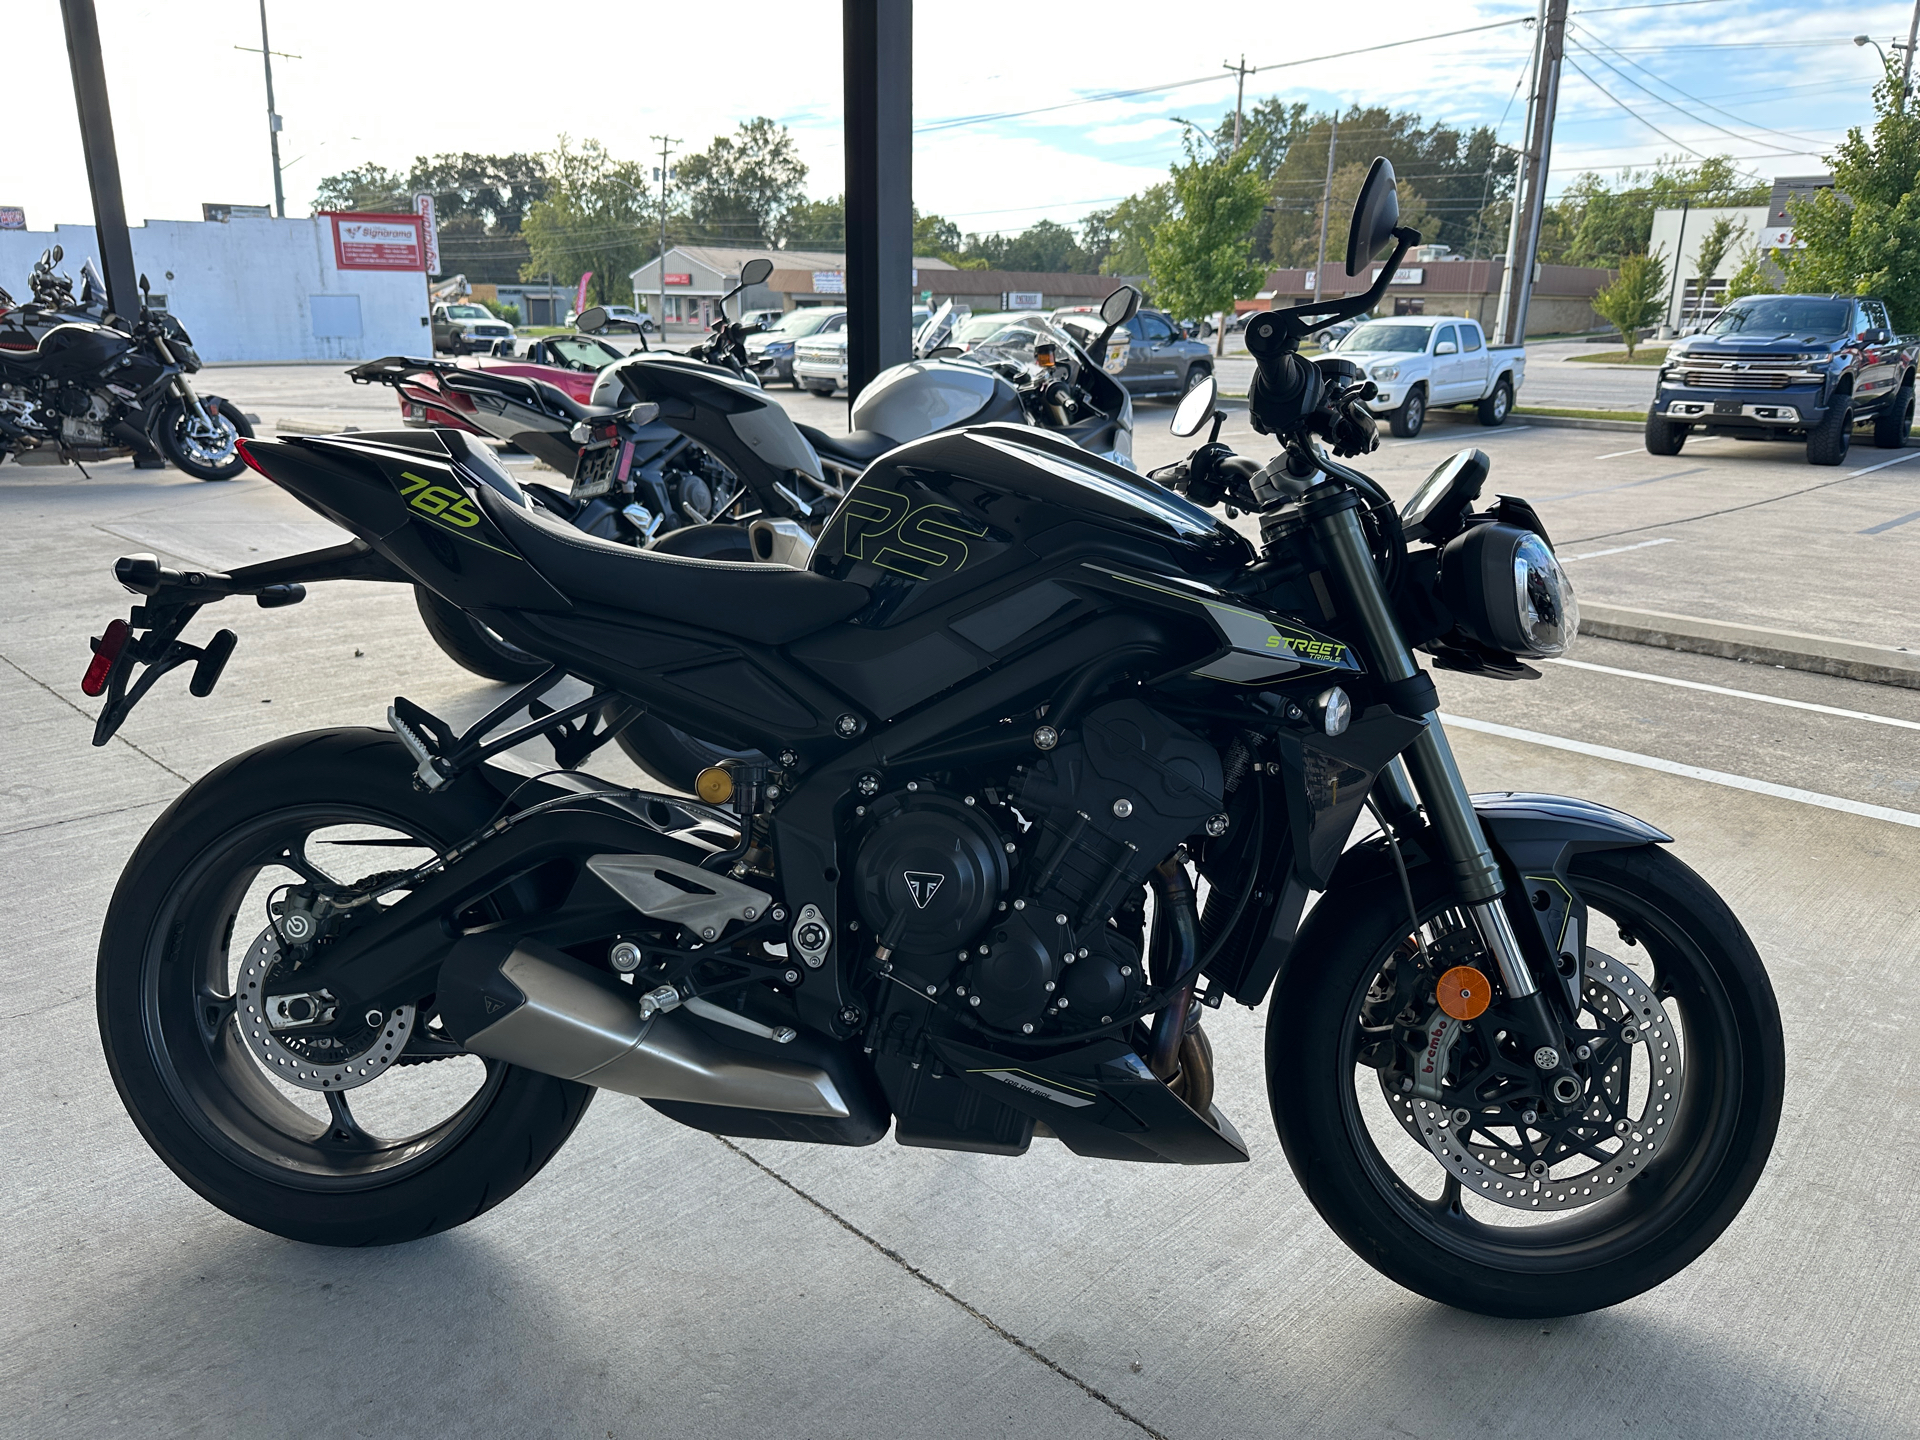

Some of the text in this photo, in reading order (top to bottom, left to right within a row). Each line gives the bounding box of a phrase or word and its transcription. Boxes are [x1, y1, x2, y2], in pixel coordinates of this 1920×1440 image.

[362, 227, 412, 239] Signarama
[400, 471, 480, 528] 765
[818, 485, 988, 581] RS
[1265, 635, 1347, 657] STREET
[1309, 653, 1342, 664] TRIPLE
[1422, 1020, 1448, 1074] brembo
[1003, 1078, 1053, 1099] FOR THE RIDE
